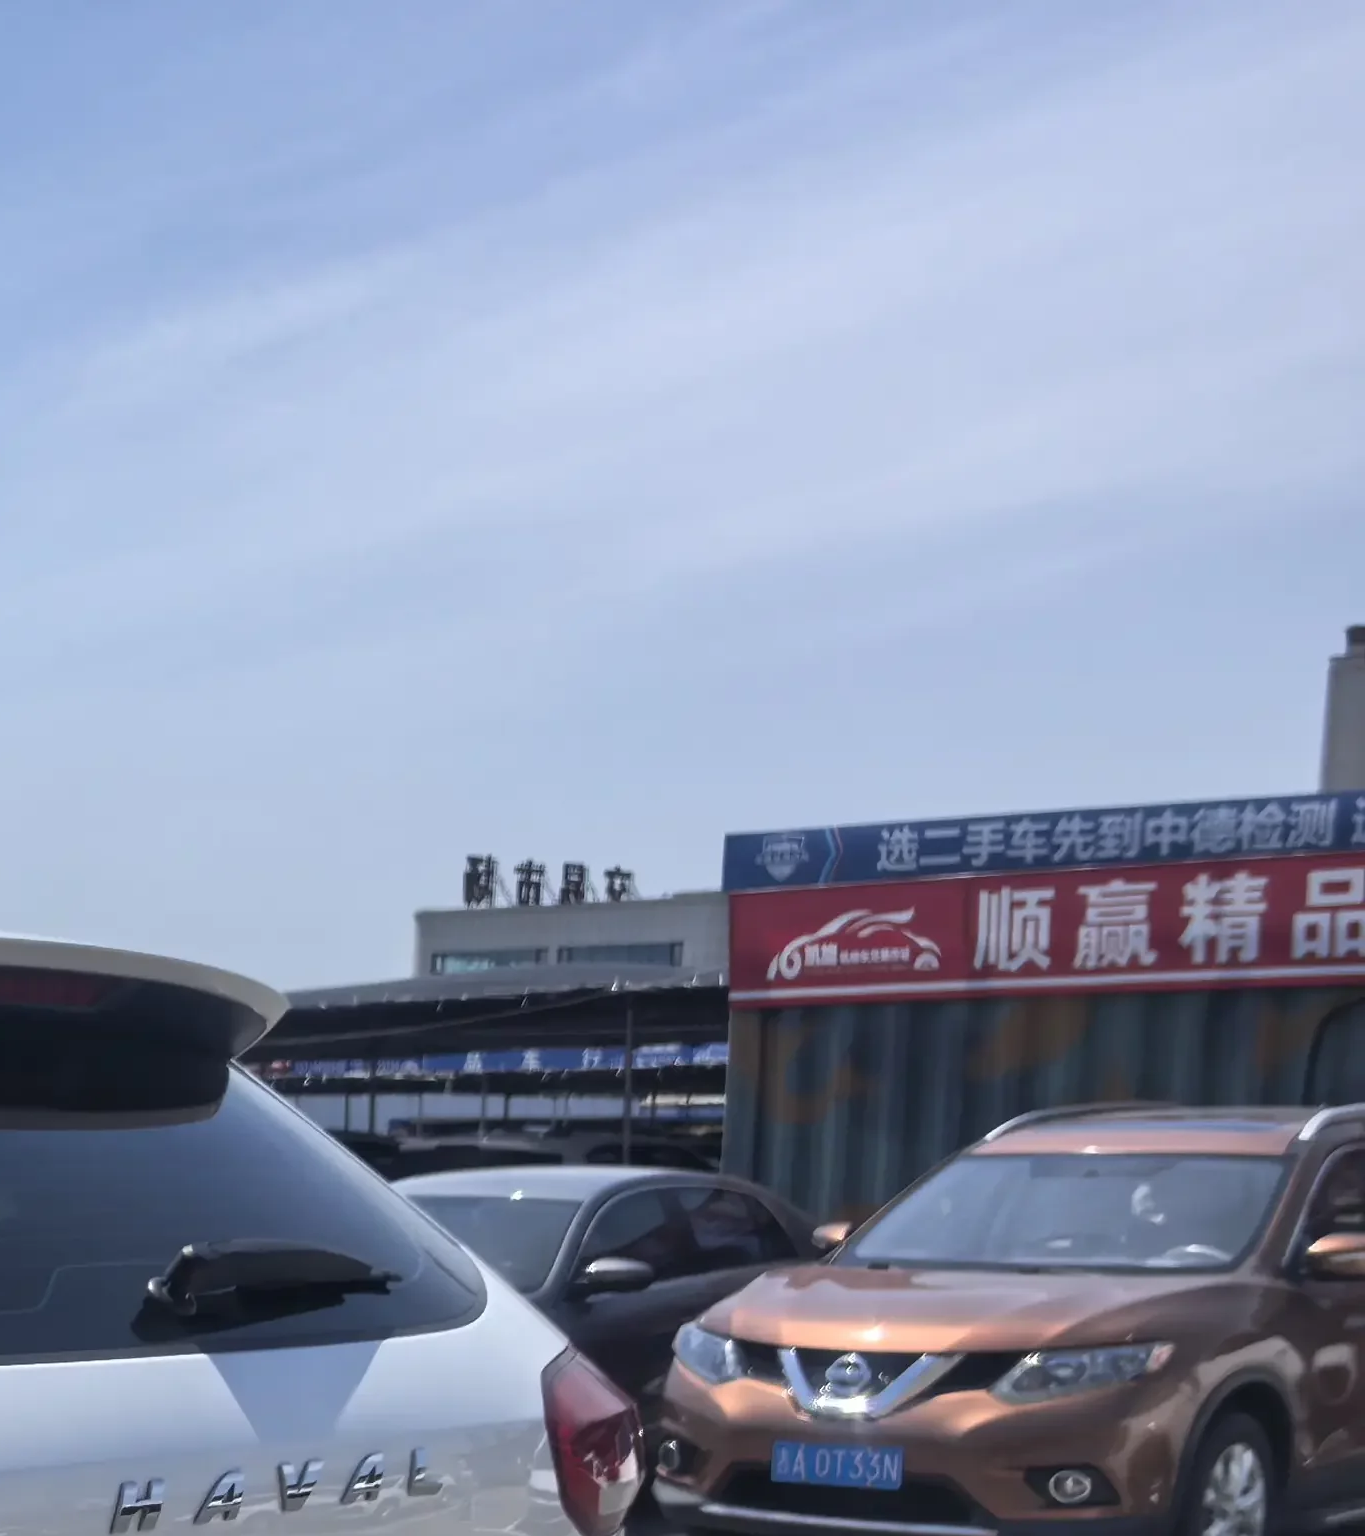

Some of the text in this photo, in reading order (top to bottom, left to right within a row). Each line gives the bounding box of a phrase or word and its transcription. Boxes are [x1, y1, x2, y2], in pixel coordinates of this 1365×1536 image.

[876, 796, 1339, 871] 选二手车先到中德检测
[973, 868, 1365, 972] 顺赢精品
[109, 1446, 444, 1534] HAVAL
